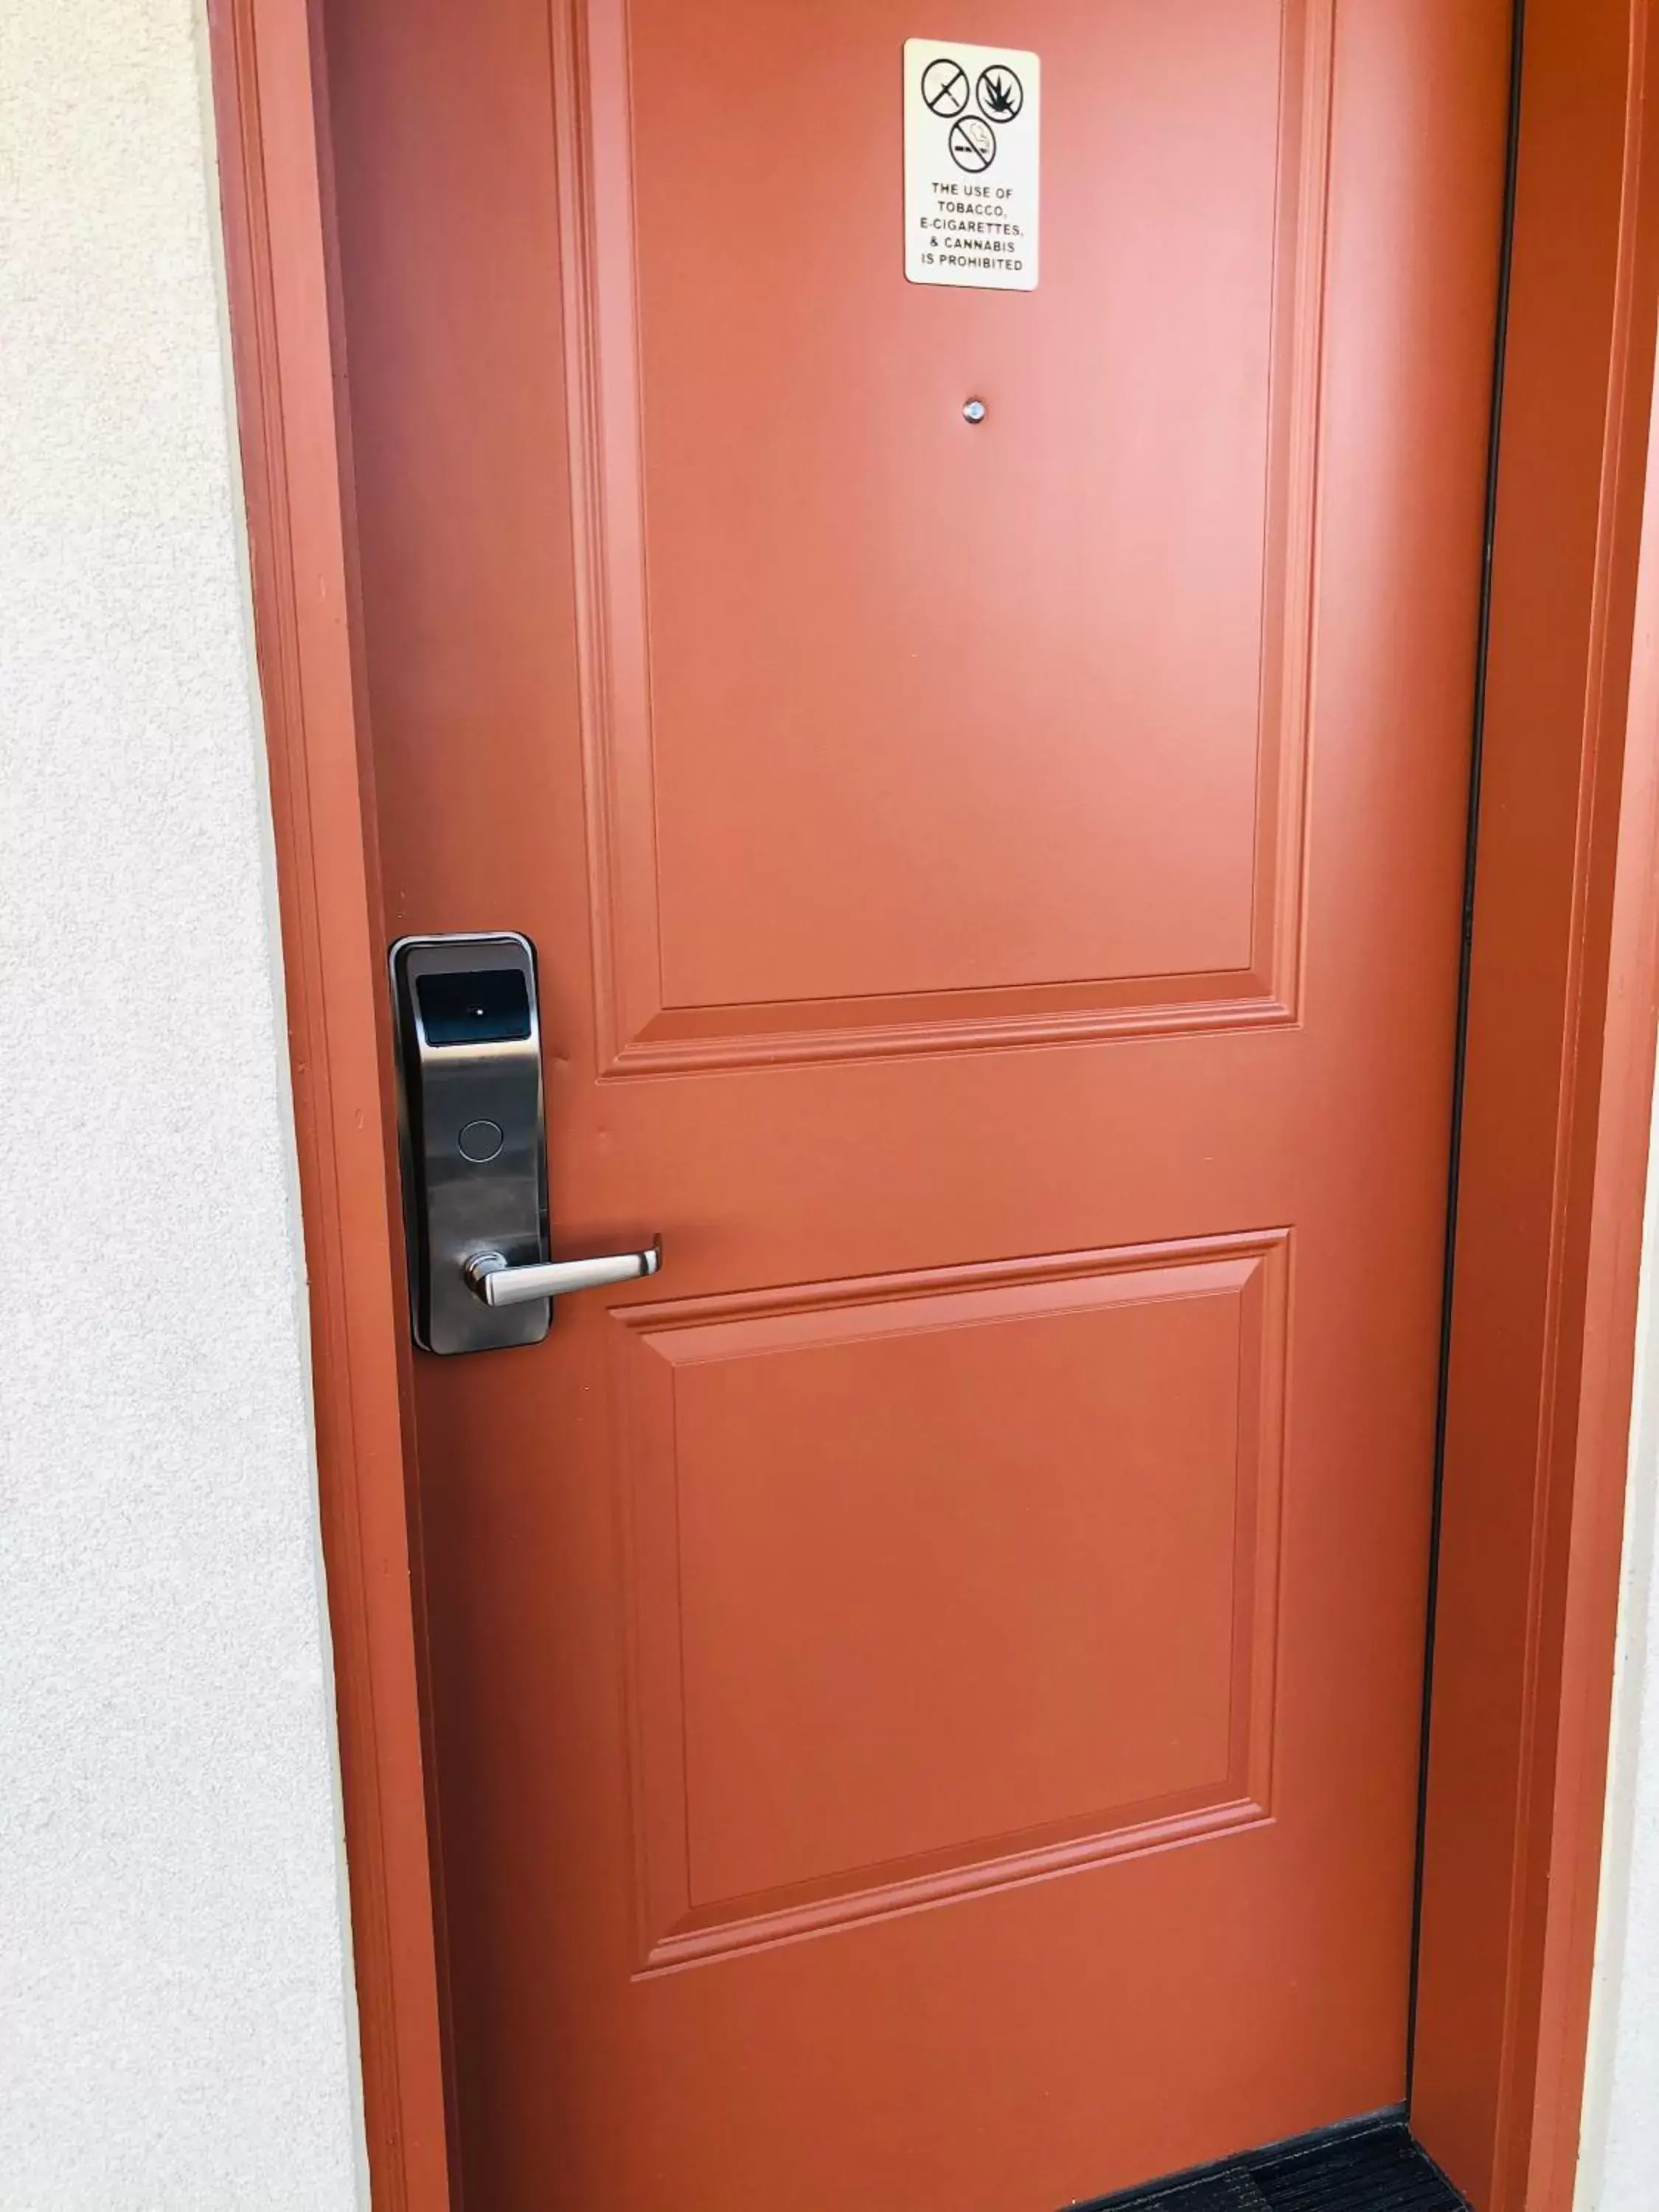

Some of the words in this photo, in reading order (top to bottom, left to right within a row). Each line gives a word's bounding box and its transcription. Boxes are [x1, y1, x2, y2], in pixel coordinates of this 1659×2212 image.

[932, 183, 958, 195] THE
[964, 185, 990, 198] USE
[996, 187, 1012, 199] OF
[938, 201, 1006, 218] TOBACCO,
[920, 218, 1023, 236] E-CIGARETTES,
[930, 237, 938, 247] &
[945, 238, 1015, 252] CANNABIS
[922, 254, 934, 264] IS
[939, 255, 1023, 271] PROHIBITED
